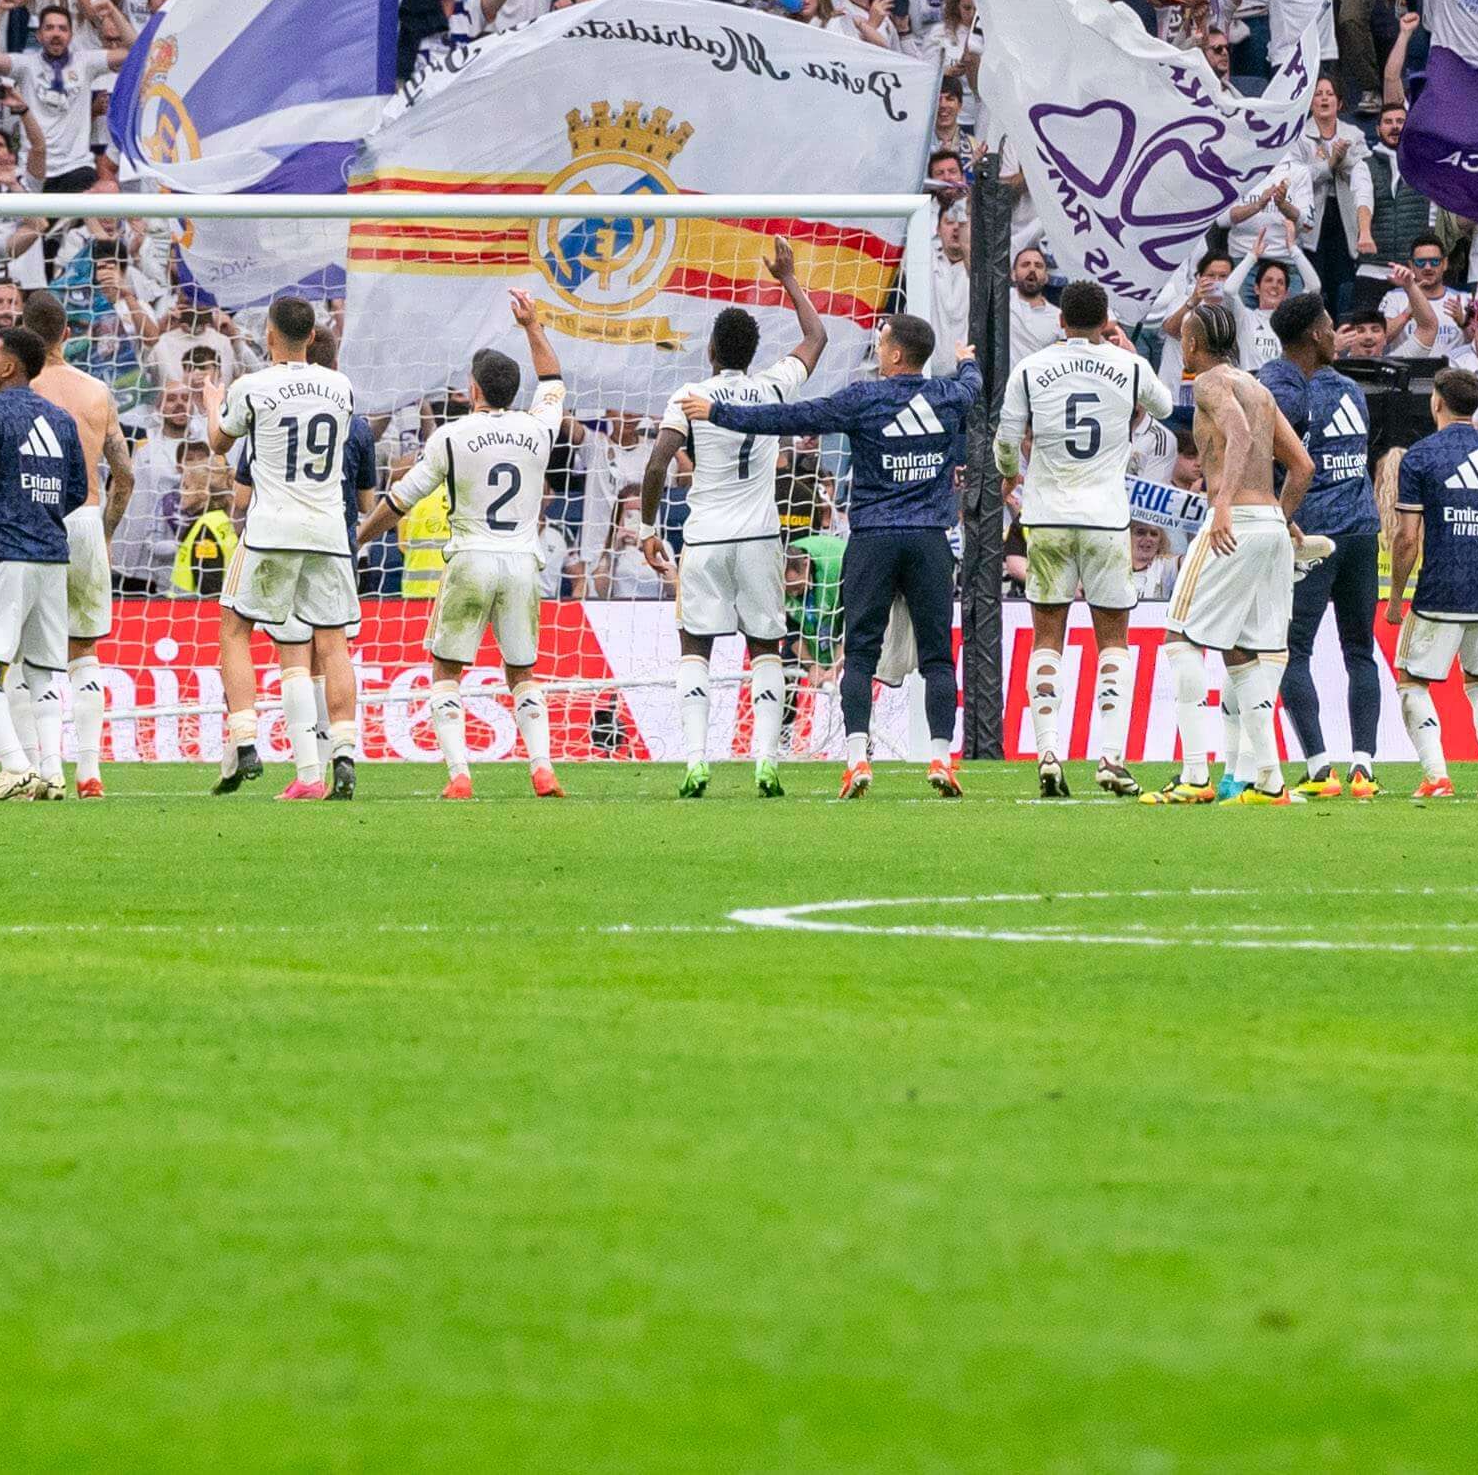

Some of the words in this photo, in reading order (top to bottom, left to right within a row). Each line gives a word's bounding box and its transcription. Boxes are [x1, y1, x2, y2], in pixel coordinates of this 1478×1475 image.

[1036, 358, 1128, 388] BELLINGHAM
[280, 382, 347, 410] CEBALLOS
[739, 388, 762, 403] JR.
[1065, 393, 1101, 459] 5
[278, 412, 338, 484] 19
[467, 431, 539, 455] CARVAJAL
[882, 451, 944, 470] Emirates
[892, 466, 908, 482] FLY
[486, 462, 520, 531] 2
